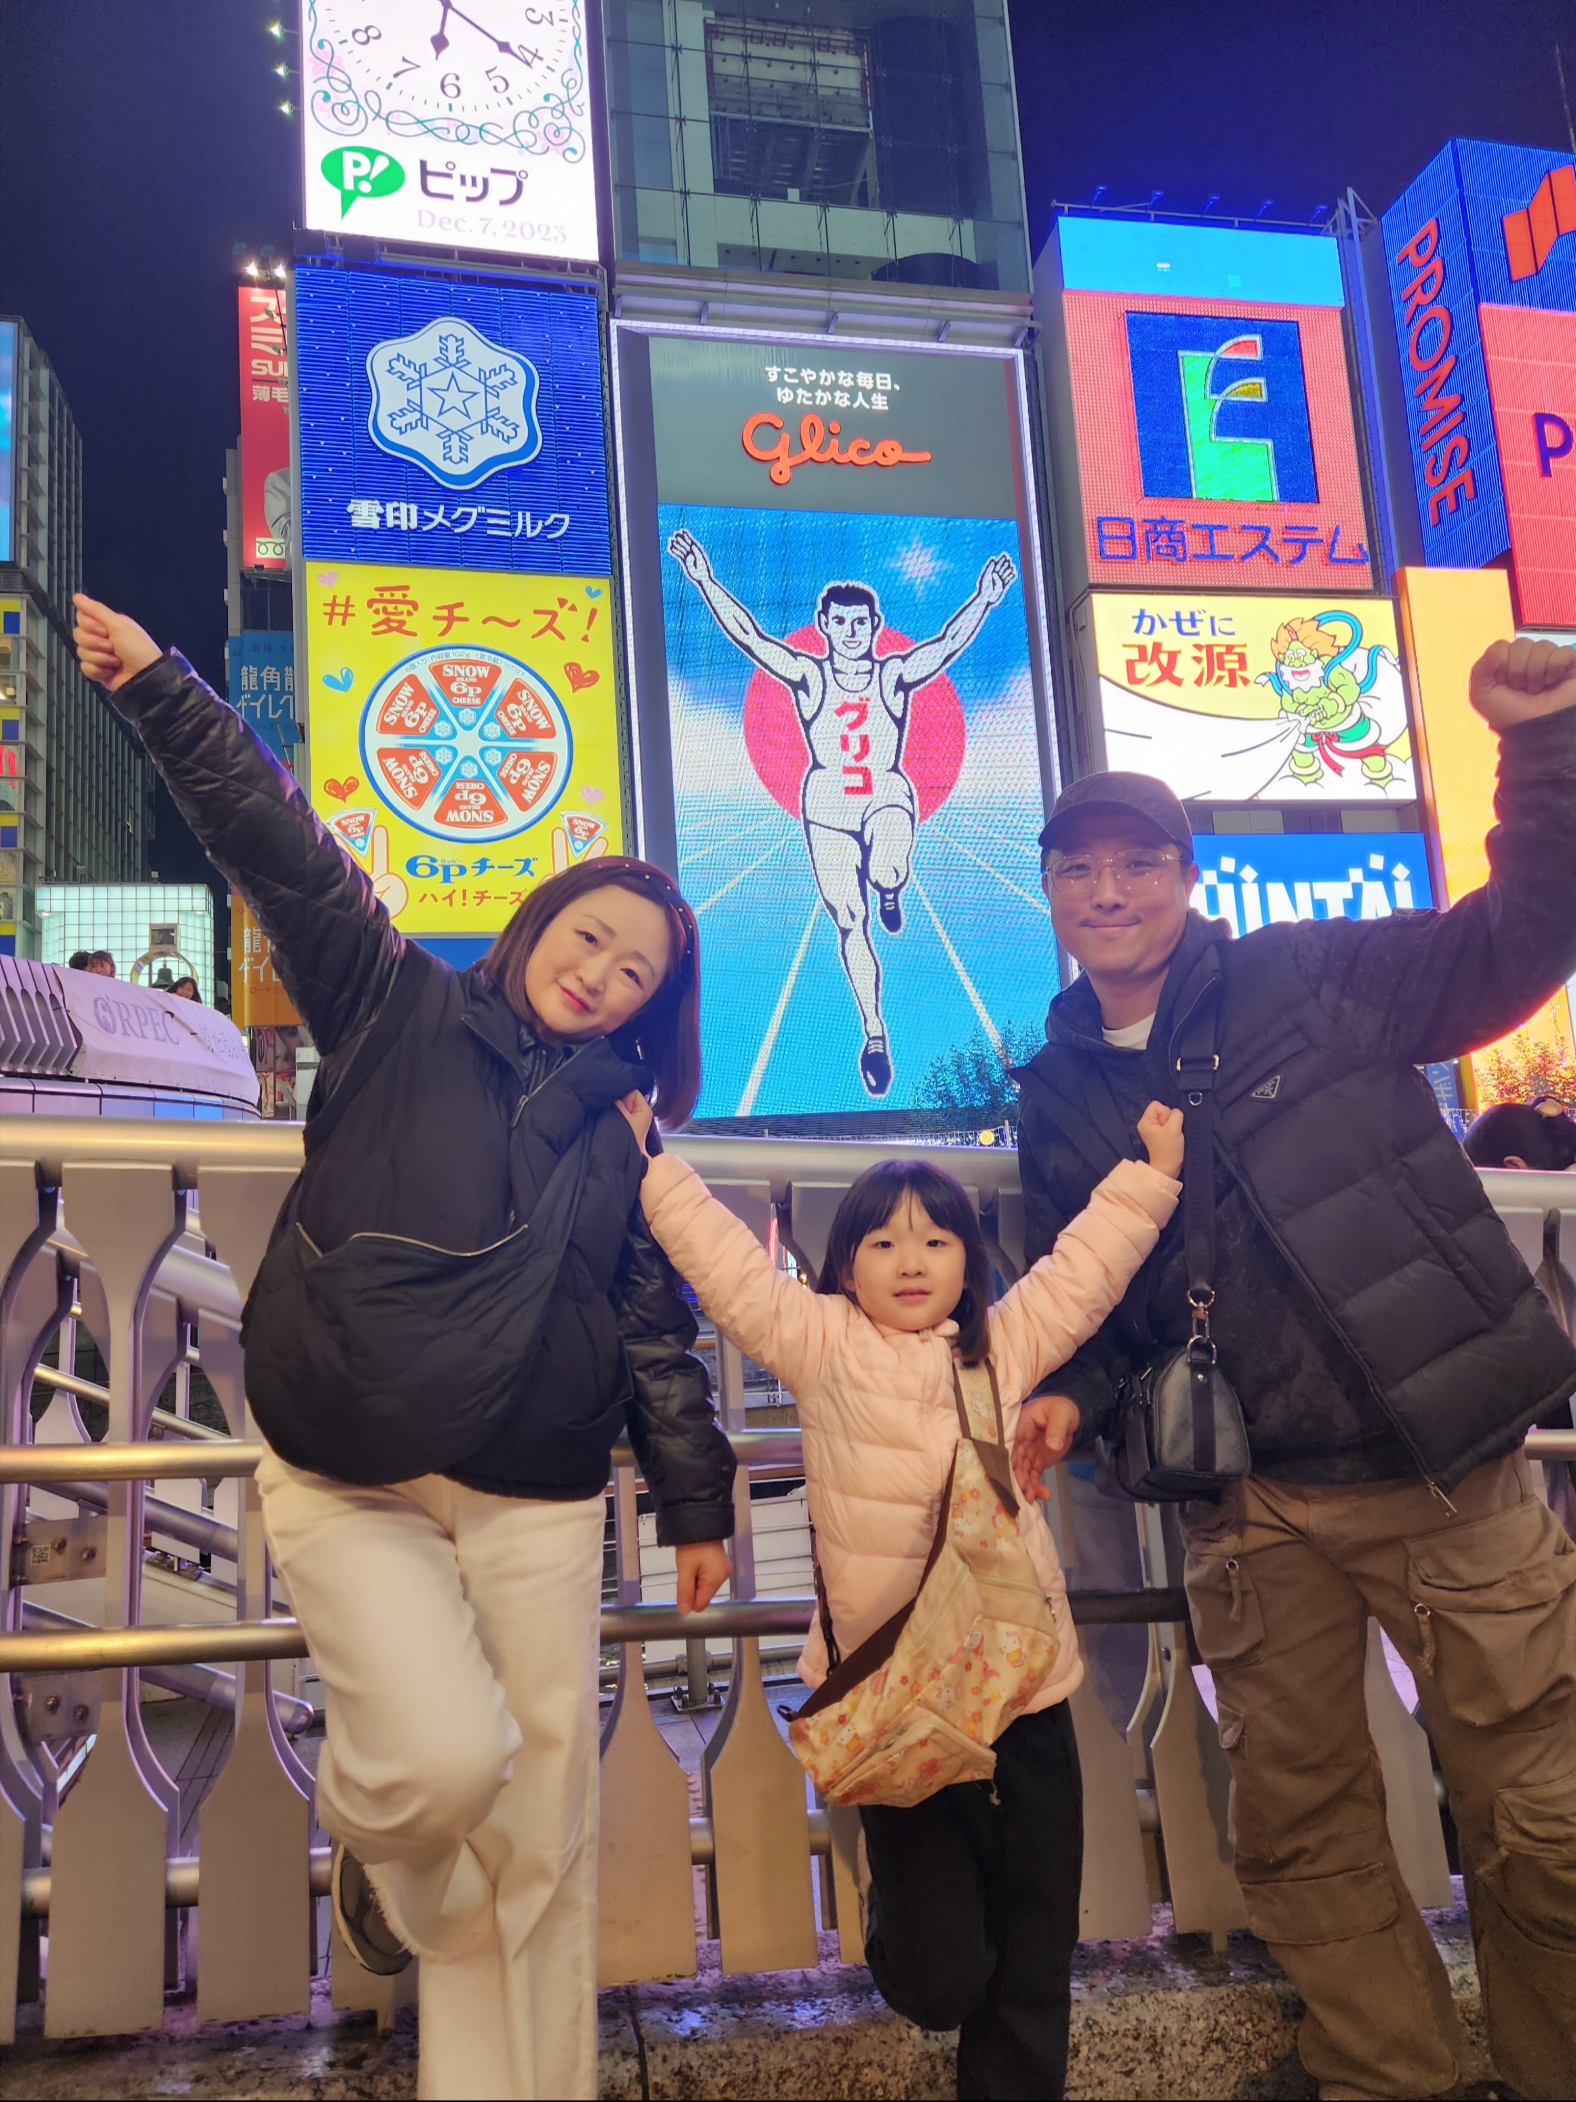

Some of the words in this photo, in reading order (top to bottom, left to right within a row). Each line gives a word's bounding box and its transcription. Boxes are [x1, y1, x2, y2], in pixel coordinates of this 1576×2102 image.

[525, 8, 553, 26] 3
[351, 25, 382, 46] 8
[393, 55, 422, 79] 7
[485, 65, 509, 93] 5
[440, 73, 461, 98] 6
[420, 159, 529, 206] ピップ
[417, 209, 473, 233] Dec.
[479, 217, 497, 238] 7,
[503, 220, 567, 243] 2023
[764, 364, 902, 393] すこやかな毎日、
[1397, 217, 1475, 526] PROMISE
[776, 386, 890, 411] ゆたかな人生
[741, 412, 932, 485] Glico
[346, 498, 571, 540] 雪印メグミルク
[1096, 514, 1370, 567] 日商エステム
[1132, 609, 1237, 637] かぜに
[442, 664, 491, 679] SNOW
[1122, 641, 1251, 688] 改源
[383, 681, 415, 726] SNOW
[452, 696, 481, 705] CHEESE
[516, 688, 552, 730] SNOW
[834, 697, 874, 796] グリコ
[382, 756, 419, 799] SNOW
[455, 782, 485, 790] CHEESE
[521, 760, 551, 804] SNOW
[445, 809, 495, 823] SNOW
